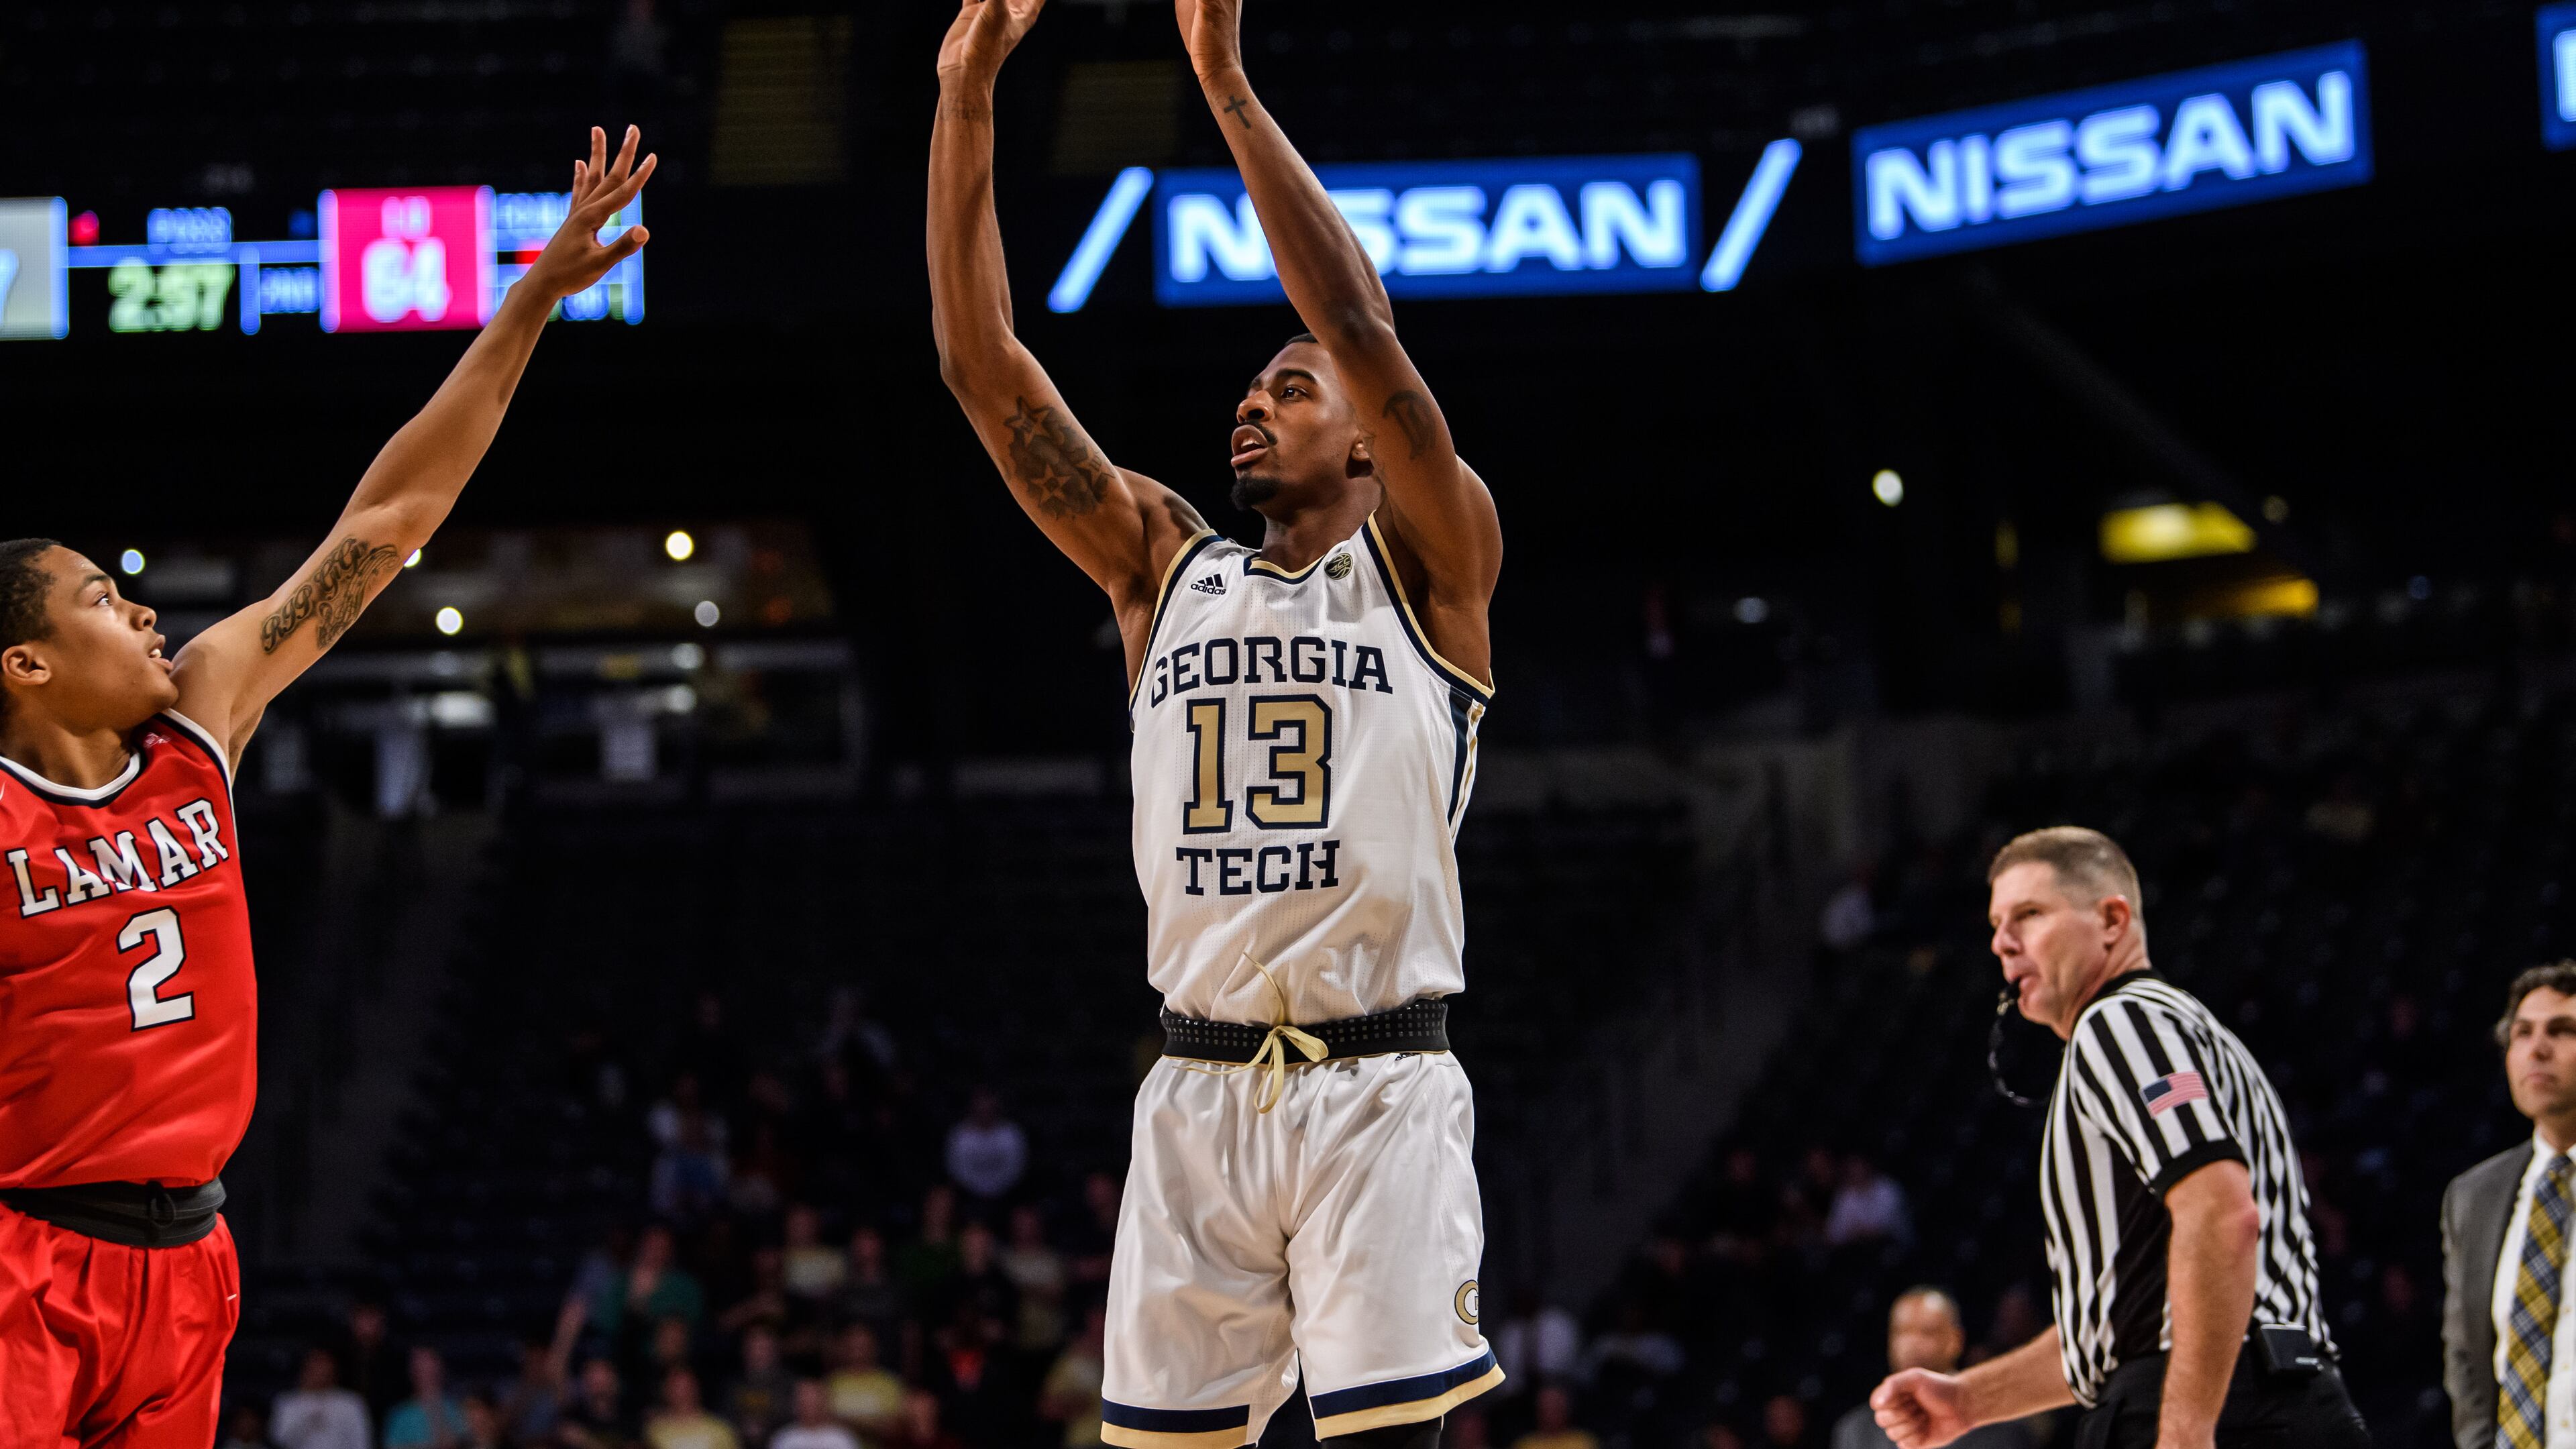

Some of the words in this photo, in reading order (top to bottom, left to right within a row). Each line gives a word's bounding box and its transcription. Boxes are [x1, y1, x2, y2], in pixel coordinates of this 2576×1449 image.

[1865, 70, 2355, 241] NISSAN
[361, 237, 451, 323] 64
[1168, 180, 1688, 283] NSSAN
[1190, 583, 1227, 596] adidas
[1150, 636, 1393, 708] GEORGIA
[1183, 694, 1332, 835] 13
[6, 799, 229, 919] LAMAR
[1176, 839, 1340, 896] TECH
[115, 905, 195, 1032] 2
